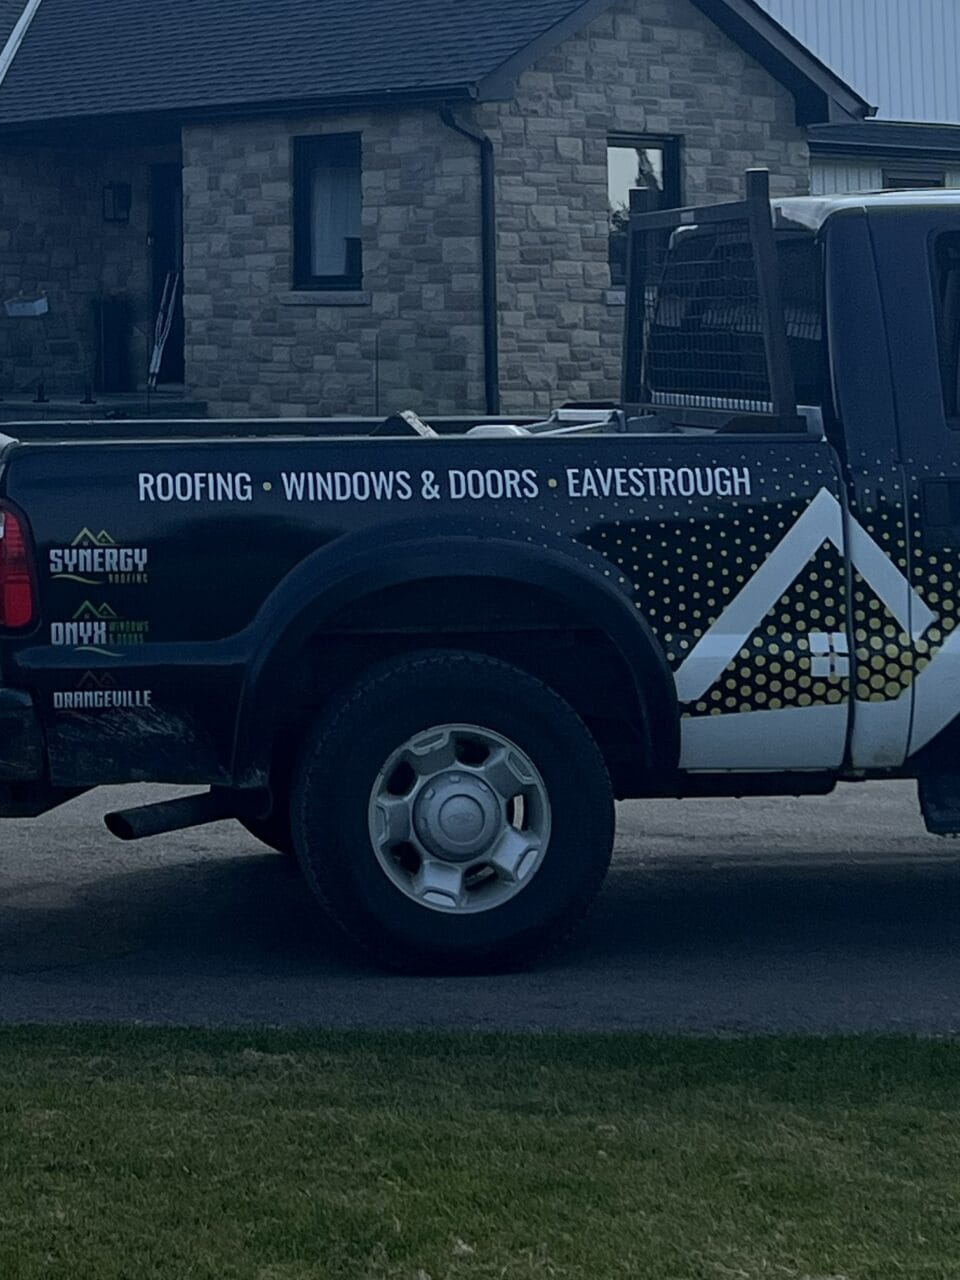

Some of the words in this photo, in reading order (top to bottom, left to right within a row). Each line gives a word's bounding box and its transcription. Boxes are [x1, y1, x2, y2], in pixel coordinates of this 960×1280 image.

[139, 473, 252, 501] ROOFING
[281, 471, 413, 501] WINDOWS
[421, 470, 440, 500] &
[448, 470, 539, 499] DOORS
[566, 467, 751, 497] EAVESTROUGH
[49, 548, 148, 573] SYNERGY
[50, 622, 107, 645] ONYX
[53, 690, 152, 709] ORANGEVILLE
